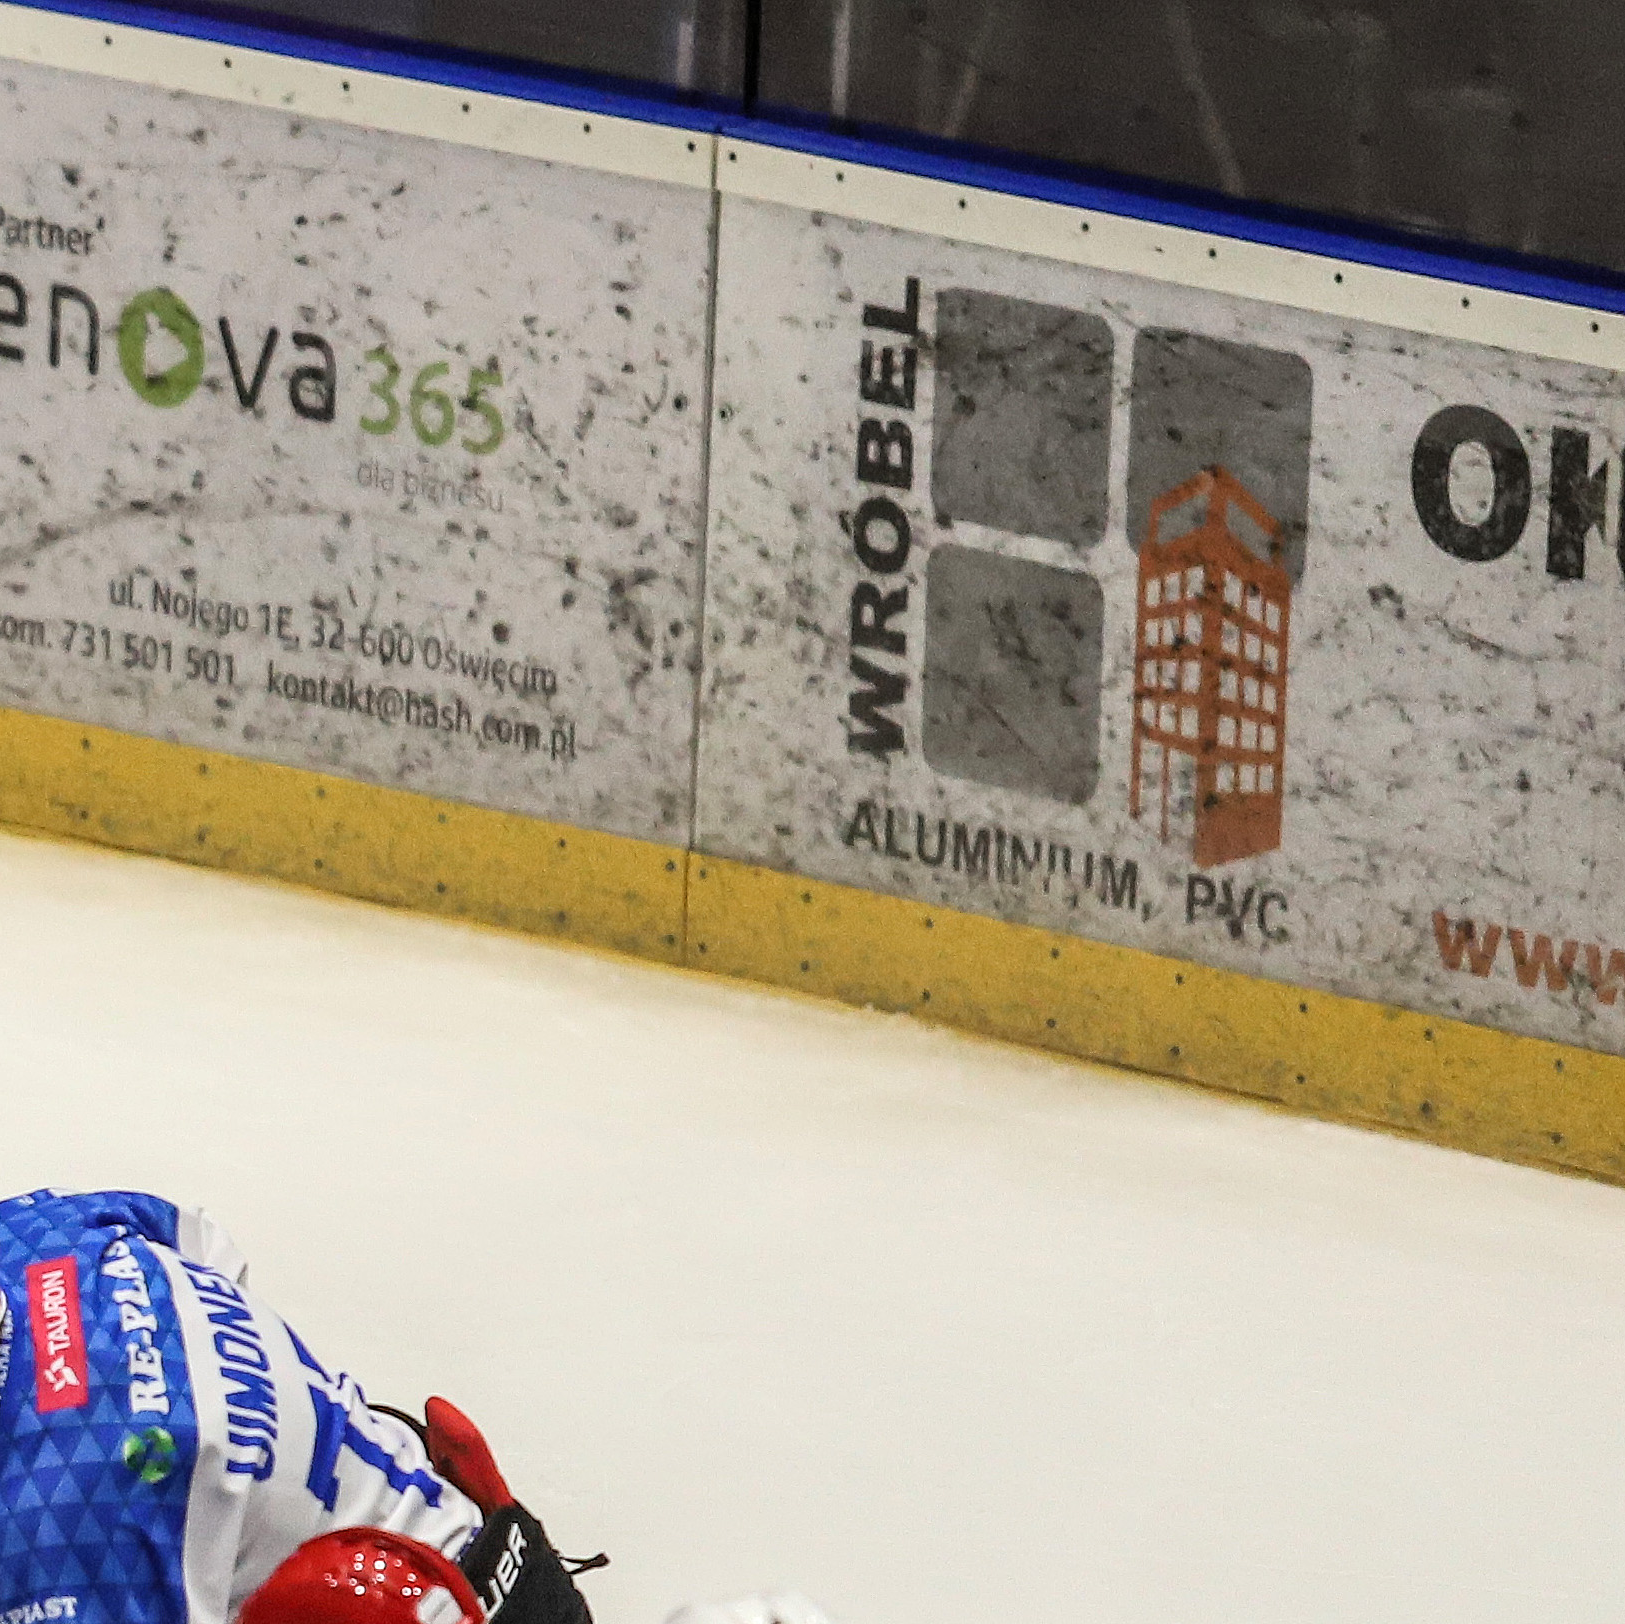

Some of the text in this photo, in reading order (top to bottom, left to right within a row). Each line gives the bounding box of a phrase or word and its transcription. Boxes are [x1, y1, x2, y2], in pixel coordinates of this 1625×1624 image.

[845, 275, 921, 760] WRÓBEL
[62, 618, 112, 661] 731
[121, 632, 174, 673] 501
[186, 646, 235, 686] 501
[152, 577, 249, 640] Nojego
[311, 611, 414, 667] 32-600
[1185, 872, 1290, 941] PVC
[41, 1268, 72, 1356] TAURON
[179, 1258, 279, 1482] UIMONE
